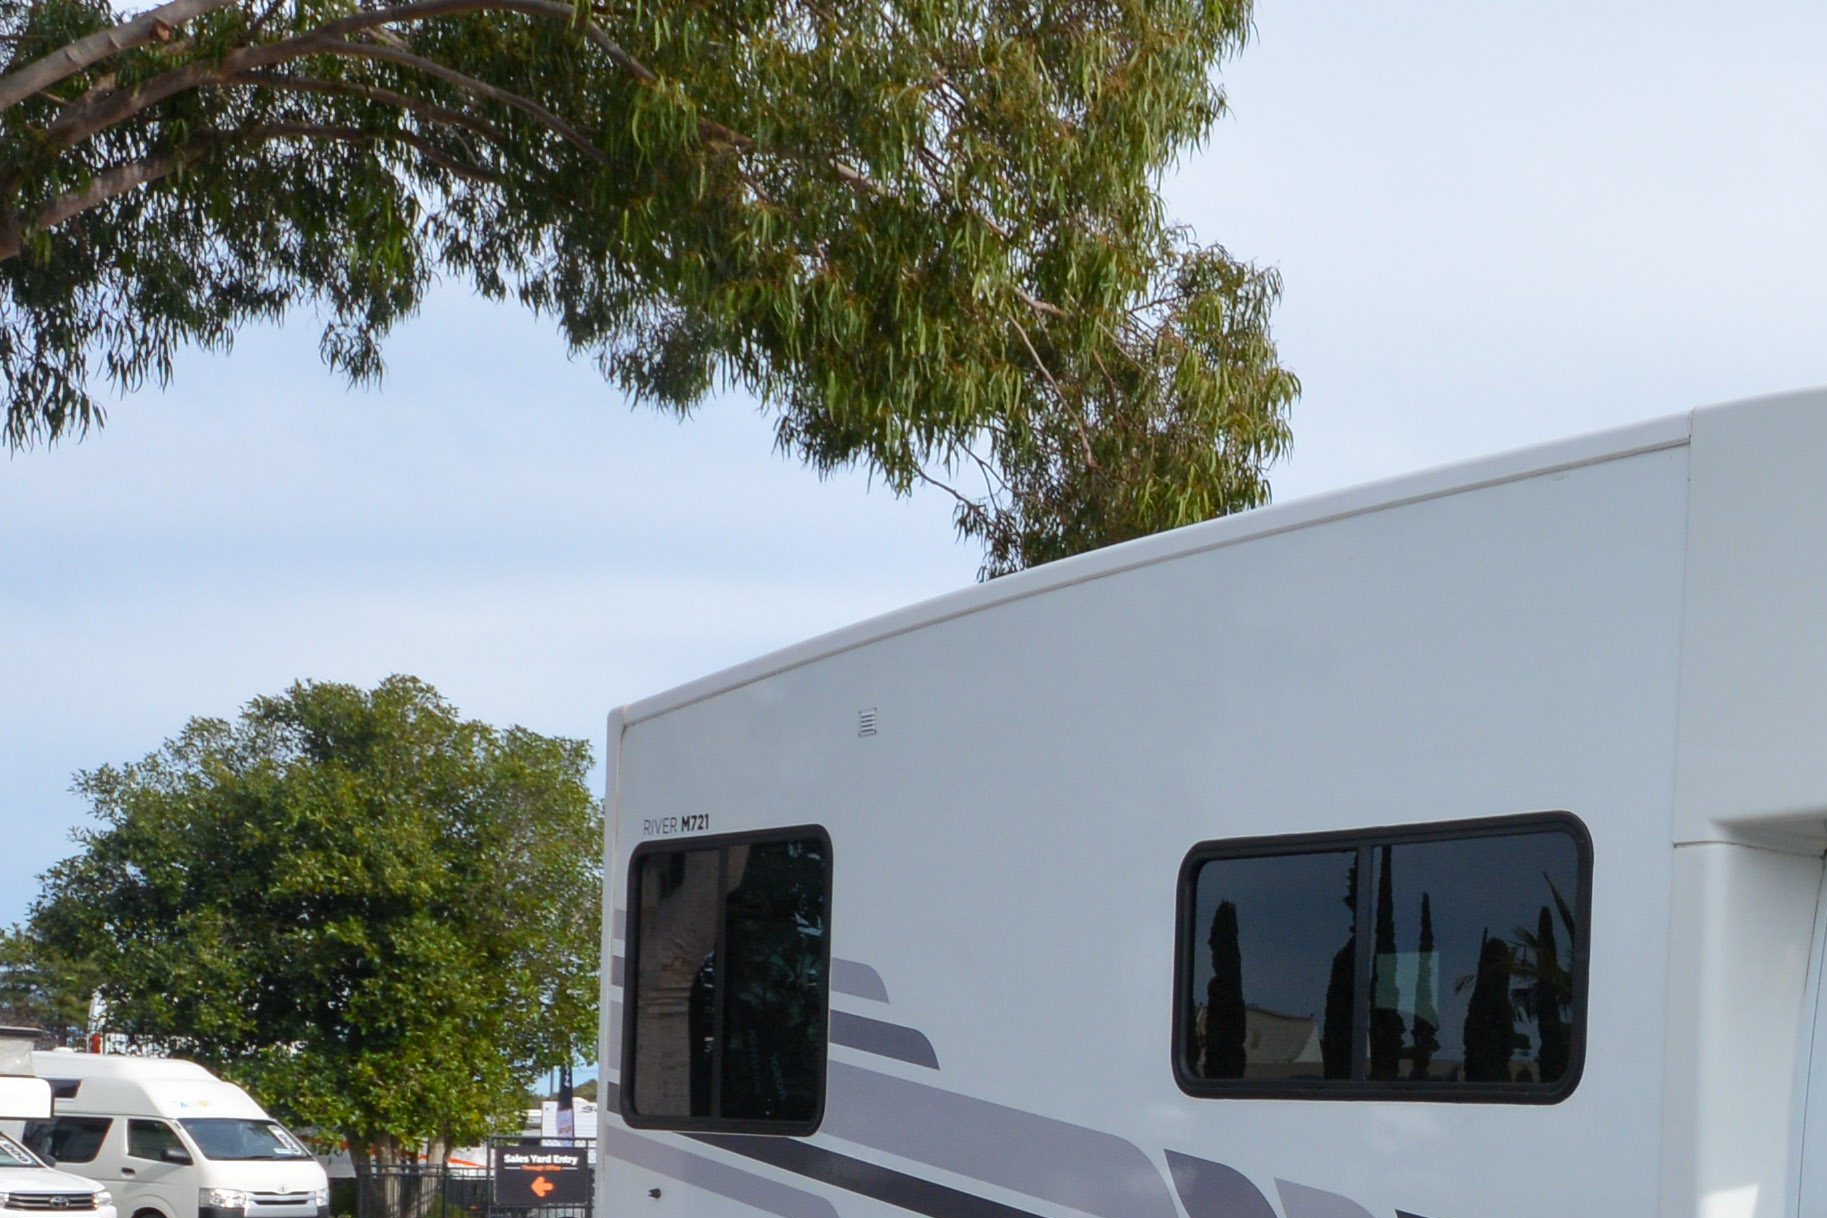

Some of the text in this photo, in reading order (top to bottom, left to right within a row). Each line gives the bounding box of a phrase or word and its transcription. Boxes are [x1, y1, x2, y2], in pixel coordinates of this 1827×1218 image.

[643, 813, 709, 836] RIVER M721
[503, 1153, 579, 1166] Sales Yard Entry
